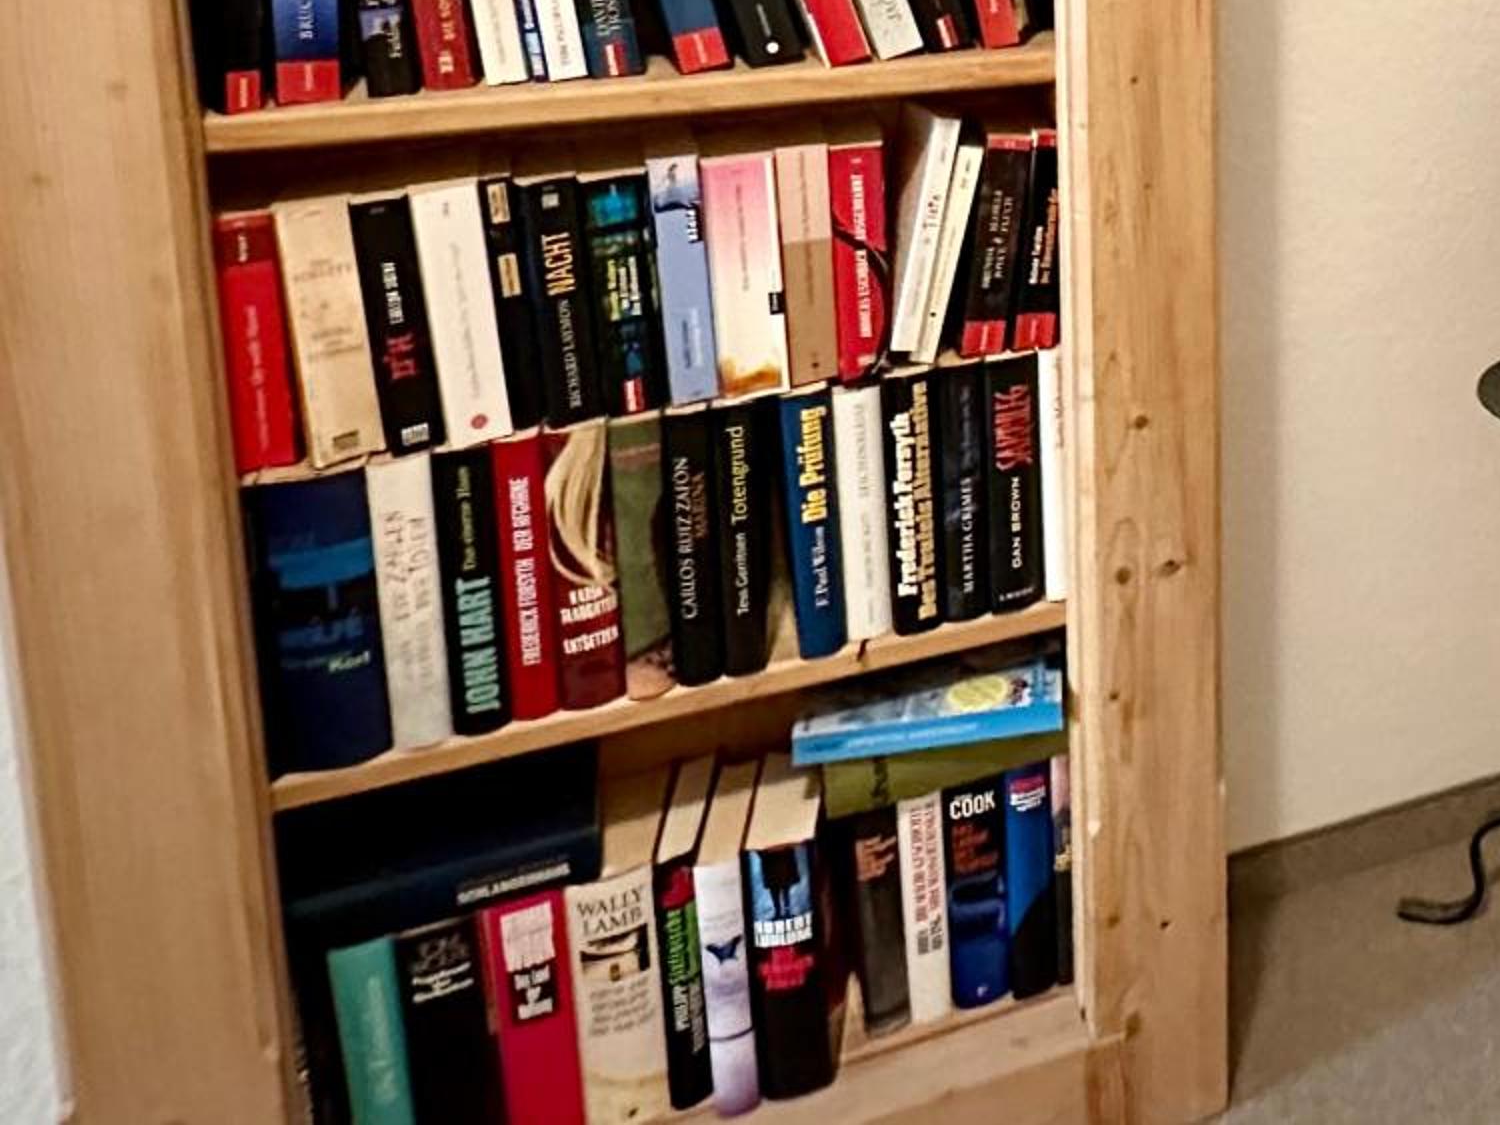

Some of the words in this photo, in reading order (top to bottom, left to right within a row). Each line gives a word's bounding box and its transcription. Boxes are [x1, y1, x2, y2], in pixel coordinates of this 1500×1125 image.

[540, 232, 577, 296] NACHT
[796, 405, 827, 486] Prüfung
[889, 412, 914, 493] Forsyth
[910, 380, 933, 500] Alternative
[508, 477, 530, 529] AFGHANE
[726, 426, 752, 523] Totengrund
[1010, 477, 1022, 532] BROWN
[801, 488, 828, 524] Die
[958, 477, 975, 533] GRIMES
[894, 493, 918, 597] Frederick
[961, 532, 975, 595] MARTHA
[1010, 536, 1022, 569] DAN
[455, 575, 495, 646] HART
[917, 580, 937, 620] Des
[521, 606, 541, 666] FREDERICK
[462, 647, 500, 715] JOHN
[949, 791, 996, 820] COOK
[576, 884, 643, 918] WALLY
[583, 907, 644, 935] LAMB
